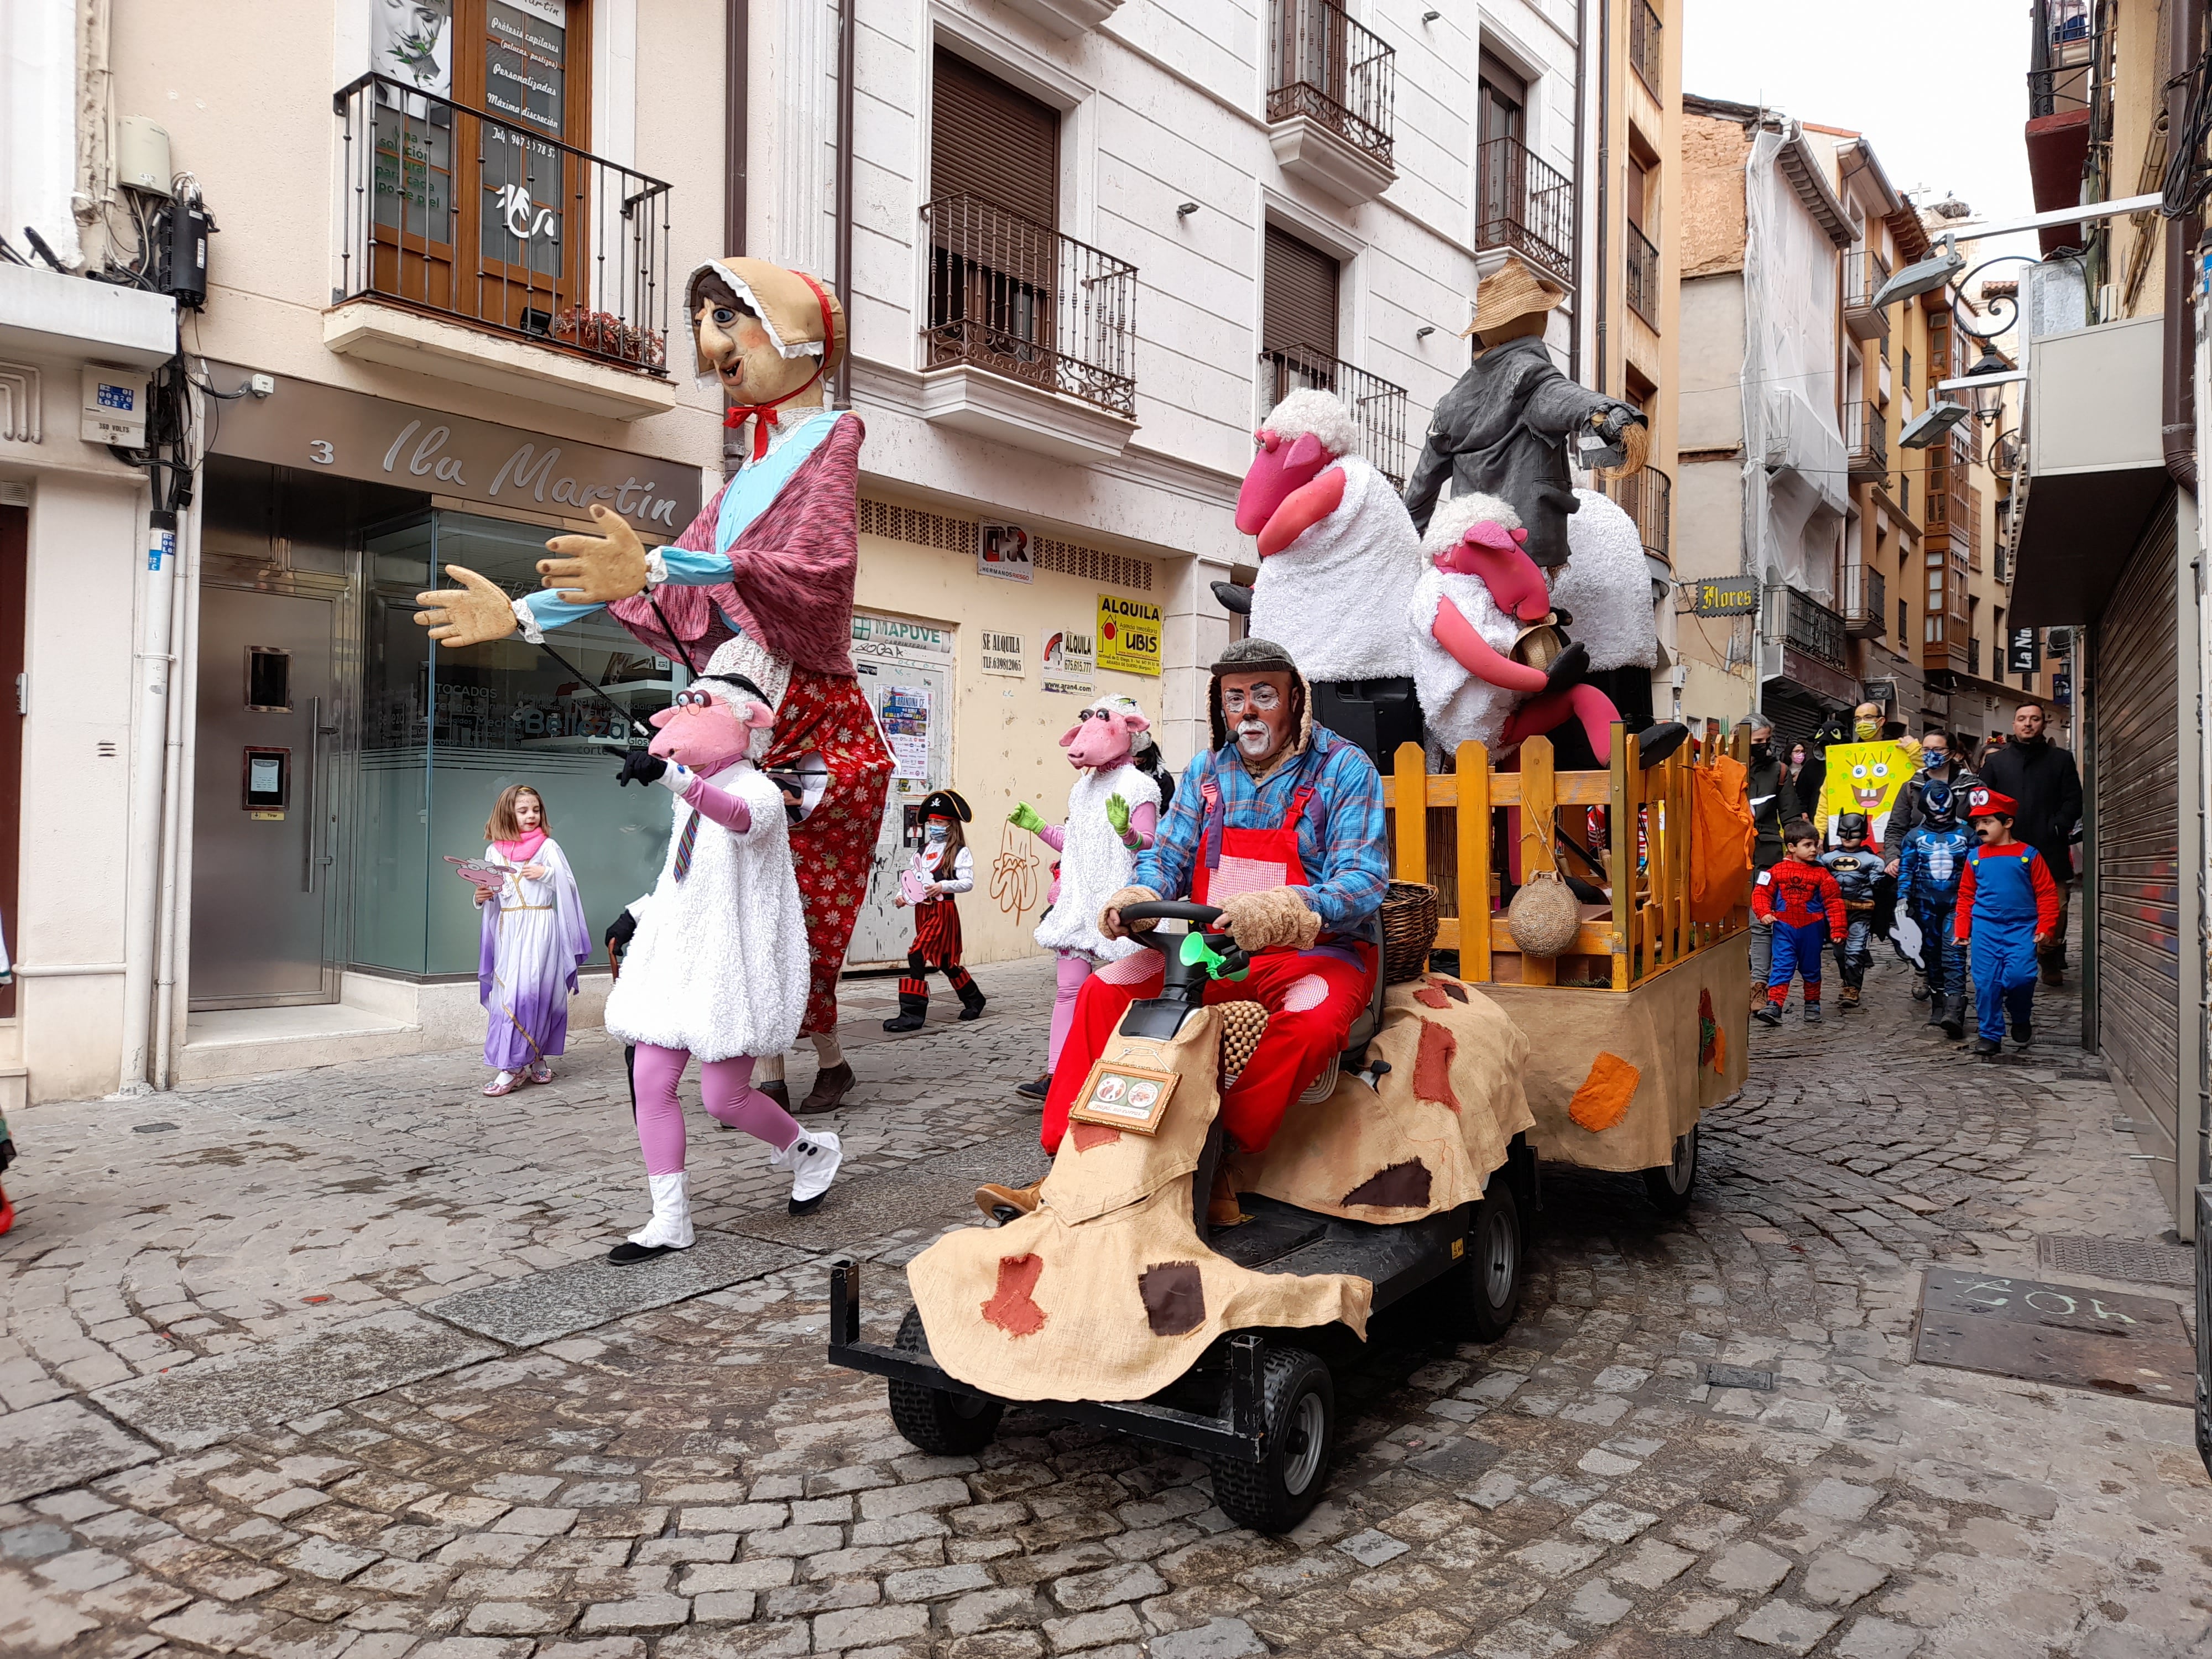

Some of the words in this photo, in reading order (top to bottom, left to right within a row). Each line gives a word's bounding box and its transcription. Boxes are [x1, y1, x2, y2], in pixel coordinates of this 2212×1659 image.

[491, 17, 523, 38] Prótesis
[525, 34, 559, 53] capilares
[530, 53, 558, 70] postizos)
[493, 63, 556, 96] Personalizadas
[487, 92, 520, 114] Máxima
[521, 107, 558, 128] discreción
[379, 138, 428, 161] solció
[512, 134, 525, 147] 947
[538, 144, 546, 155] 78
[418, 194, 440, 208] pel
[112, 425, 130, 433] VOLTS
[309, 440, 334, 464] 3
[1702, 585, 1752, 609] Flores
[1102, 598, 1159, 622] ALQUILA
[875, 619, 941, 644] MAPUVE
[2015, 627, 2032, 649] Nu
[885, 639, 927, 650] CARPINTERIA
[983, 633, 990, 650] SE
[993, 634, 1020, 654] ALQUILA
[1065, 634, 1092, 655] ALQUILA
[1126, 632, 1157, 653] UBIS
[983, 656, 1021, 671] TLF.639812065
[1065, 659, 1092, 673] 675.615.777
[2015, 651, 2032, 669] La
[435, 684, 498, 699] TOCADOS
[1044, 681, 1092, 692] www.aran4.com
[897, 697, 918, 707] ARANDINA
[919, 698, 925, 707] CF
[525, 709, 624, 740] Belleza
